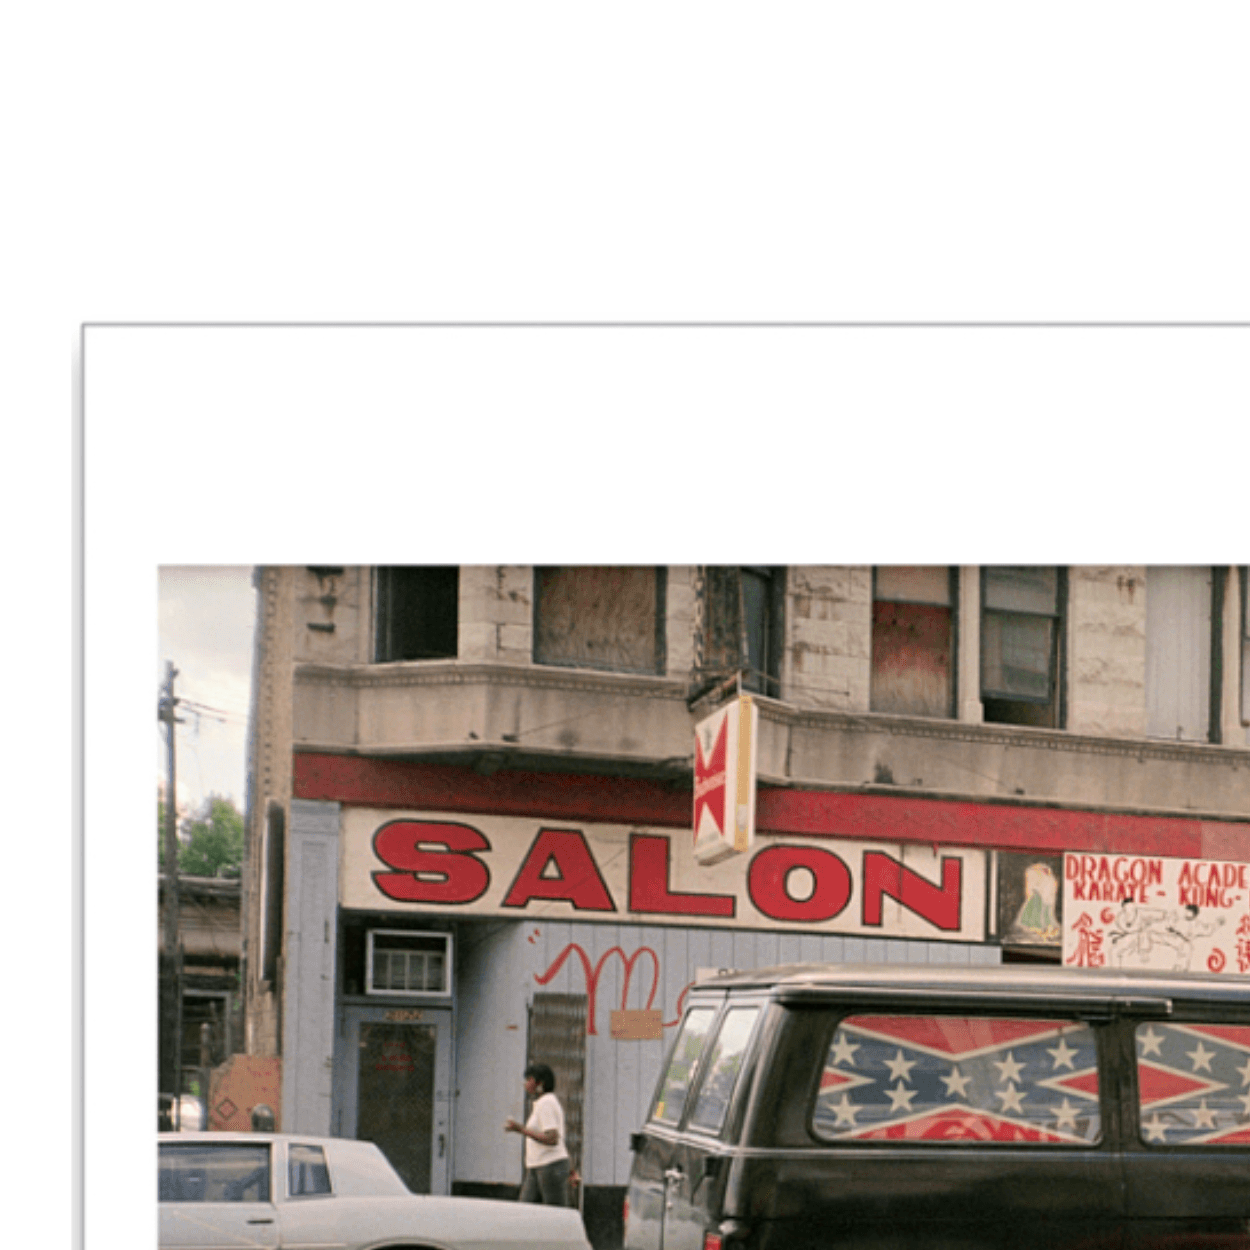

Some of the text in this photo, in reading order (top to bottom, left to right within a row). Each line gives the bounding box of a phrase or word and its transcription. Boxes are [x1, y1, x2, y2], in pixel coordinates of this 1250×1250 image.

[371, 819, 964, 932] SALON
[1065, 854, 1164, 886] DRAGON
[1073, 880, 1148, 904] KARATE
